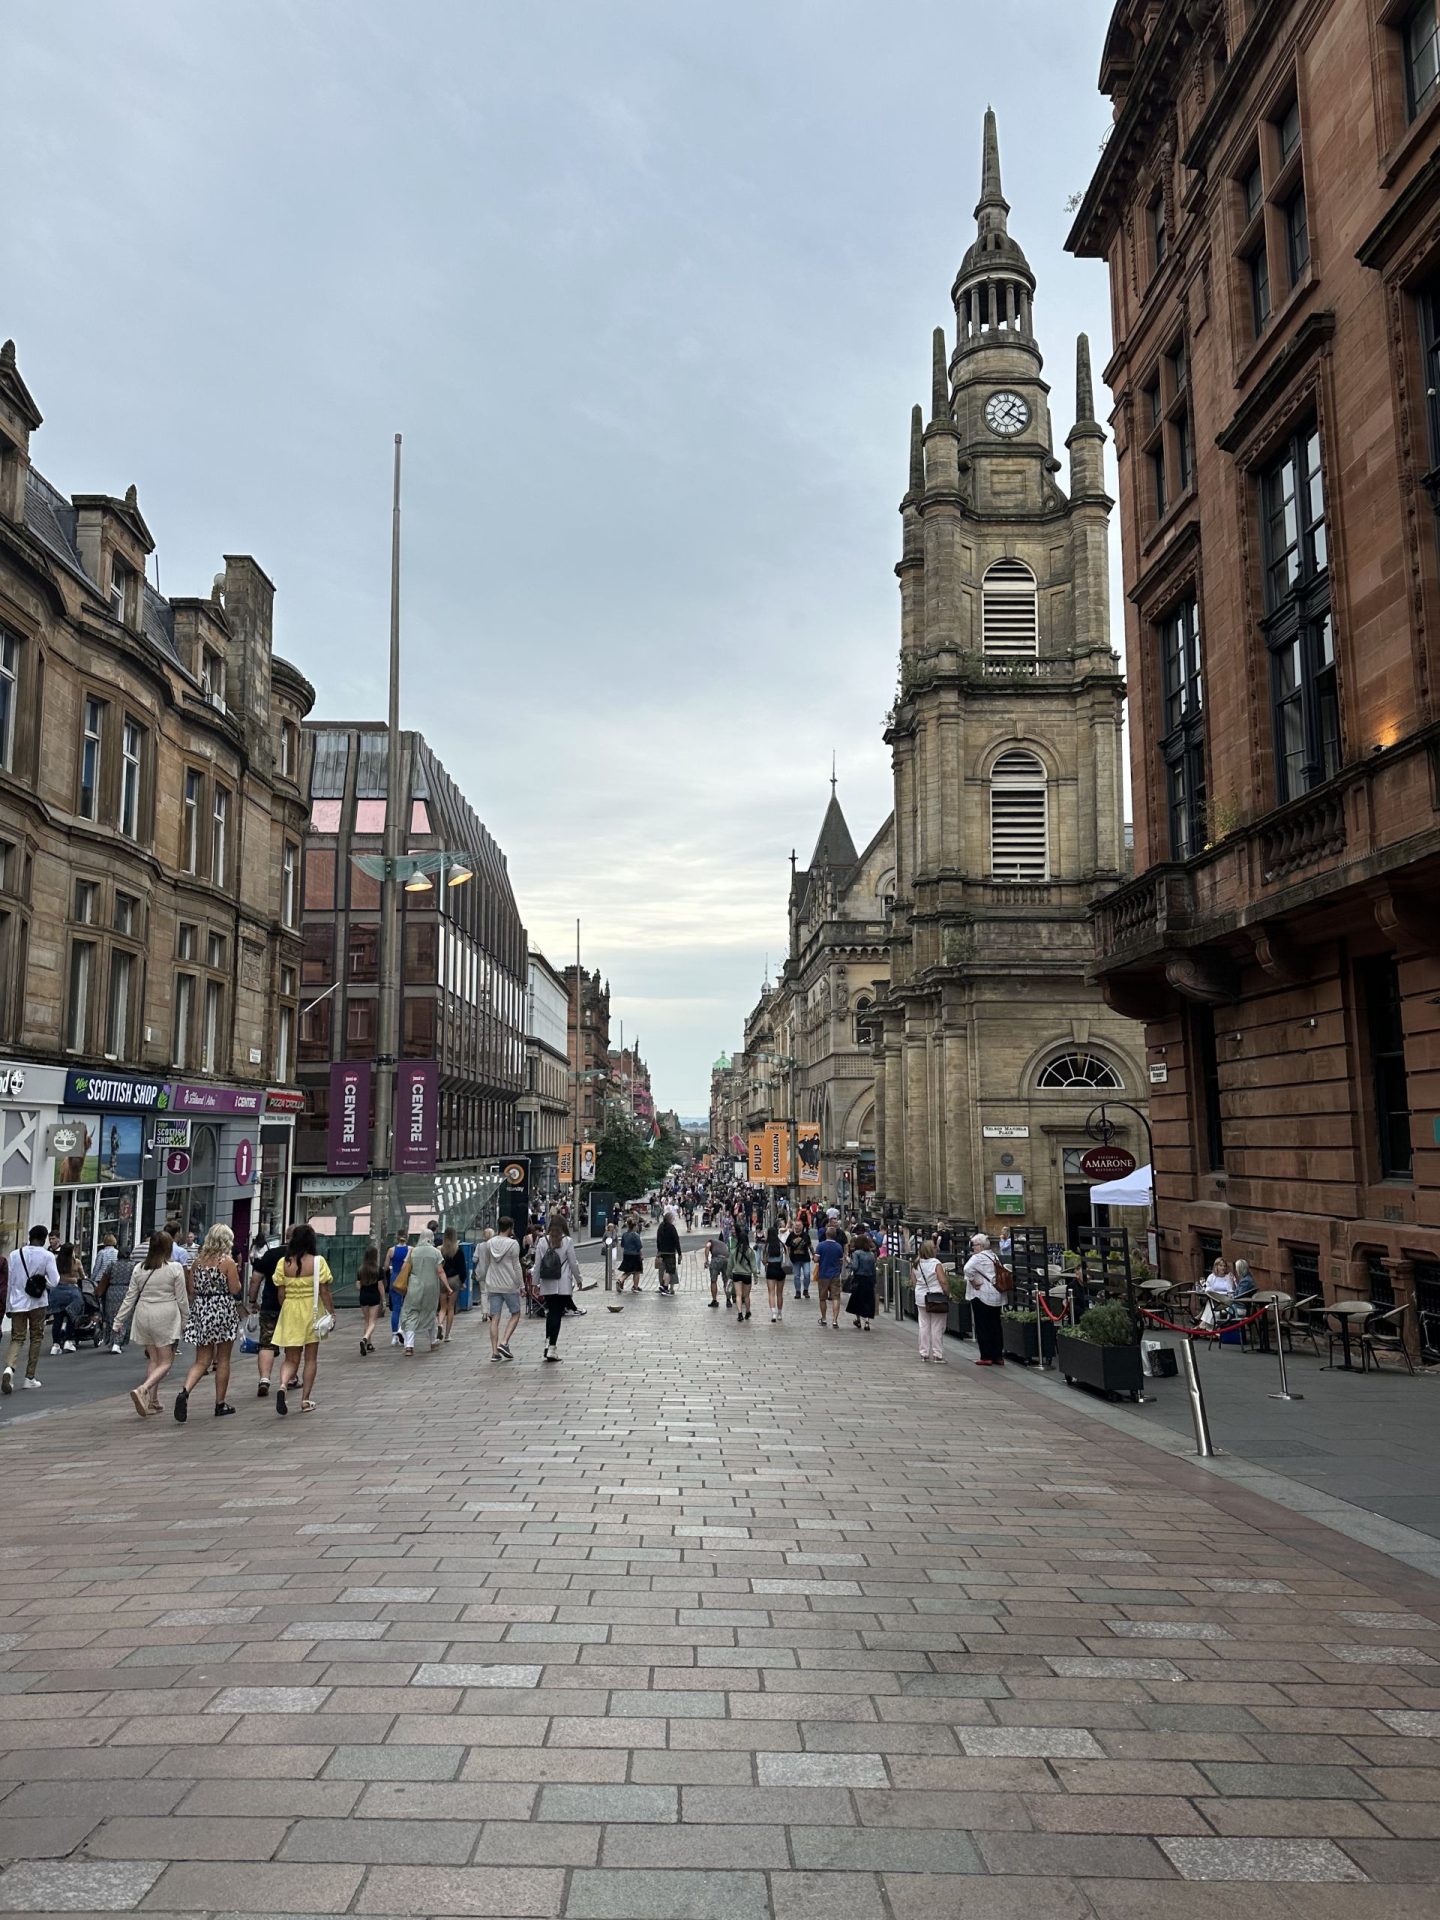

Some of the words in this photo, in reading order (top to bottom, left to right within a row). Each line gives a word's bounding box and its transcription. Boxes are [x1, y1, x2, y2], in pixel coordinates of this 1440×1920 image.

[87, 1078, 133, 1103] SCOTTISH
[133, 1084, 158, 1105] SHOP
[269, 1098, 285, 1107] PIZZA
[343, 1084, 357, 1143] CENTRE
[410, 1083, 424, 1142] CENTRE
[157, 1128, 186, 1137] SCOTTISH
[156, 1136, 172, 1144] SHOP
[753, 1144, 762, 1171] PULP
[1085, 1159, 1133, 1168] AMARONE
[303, 1180, 327, 1188] NEW
